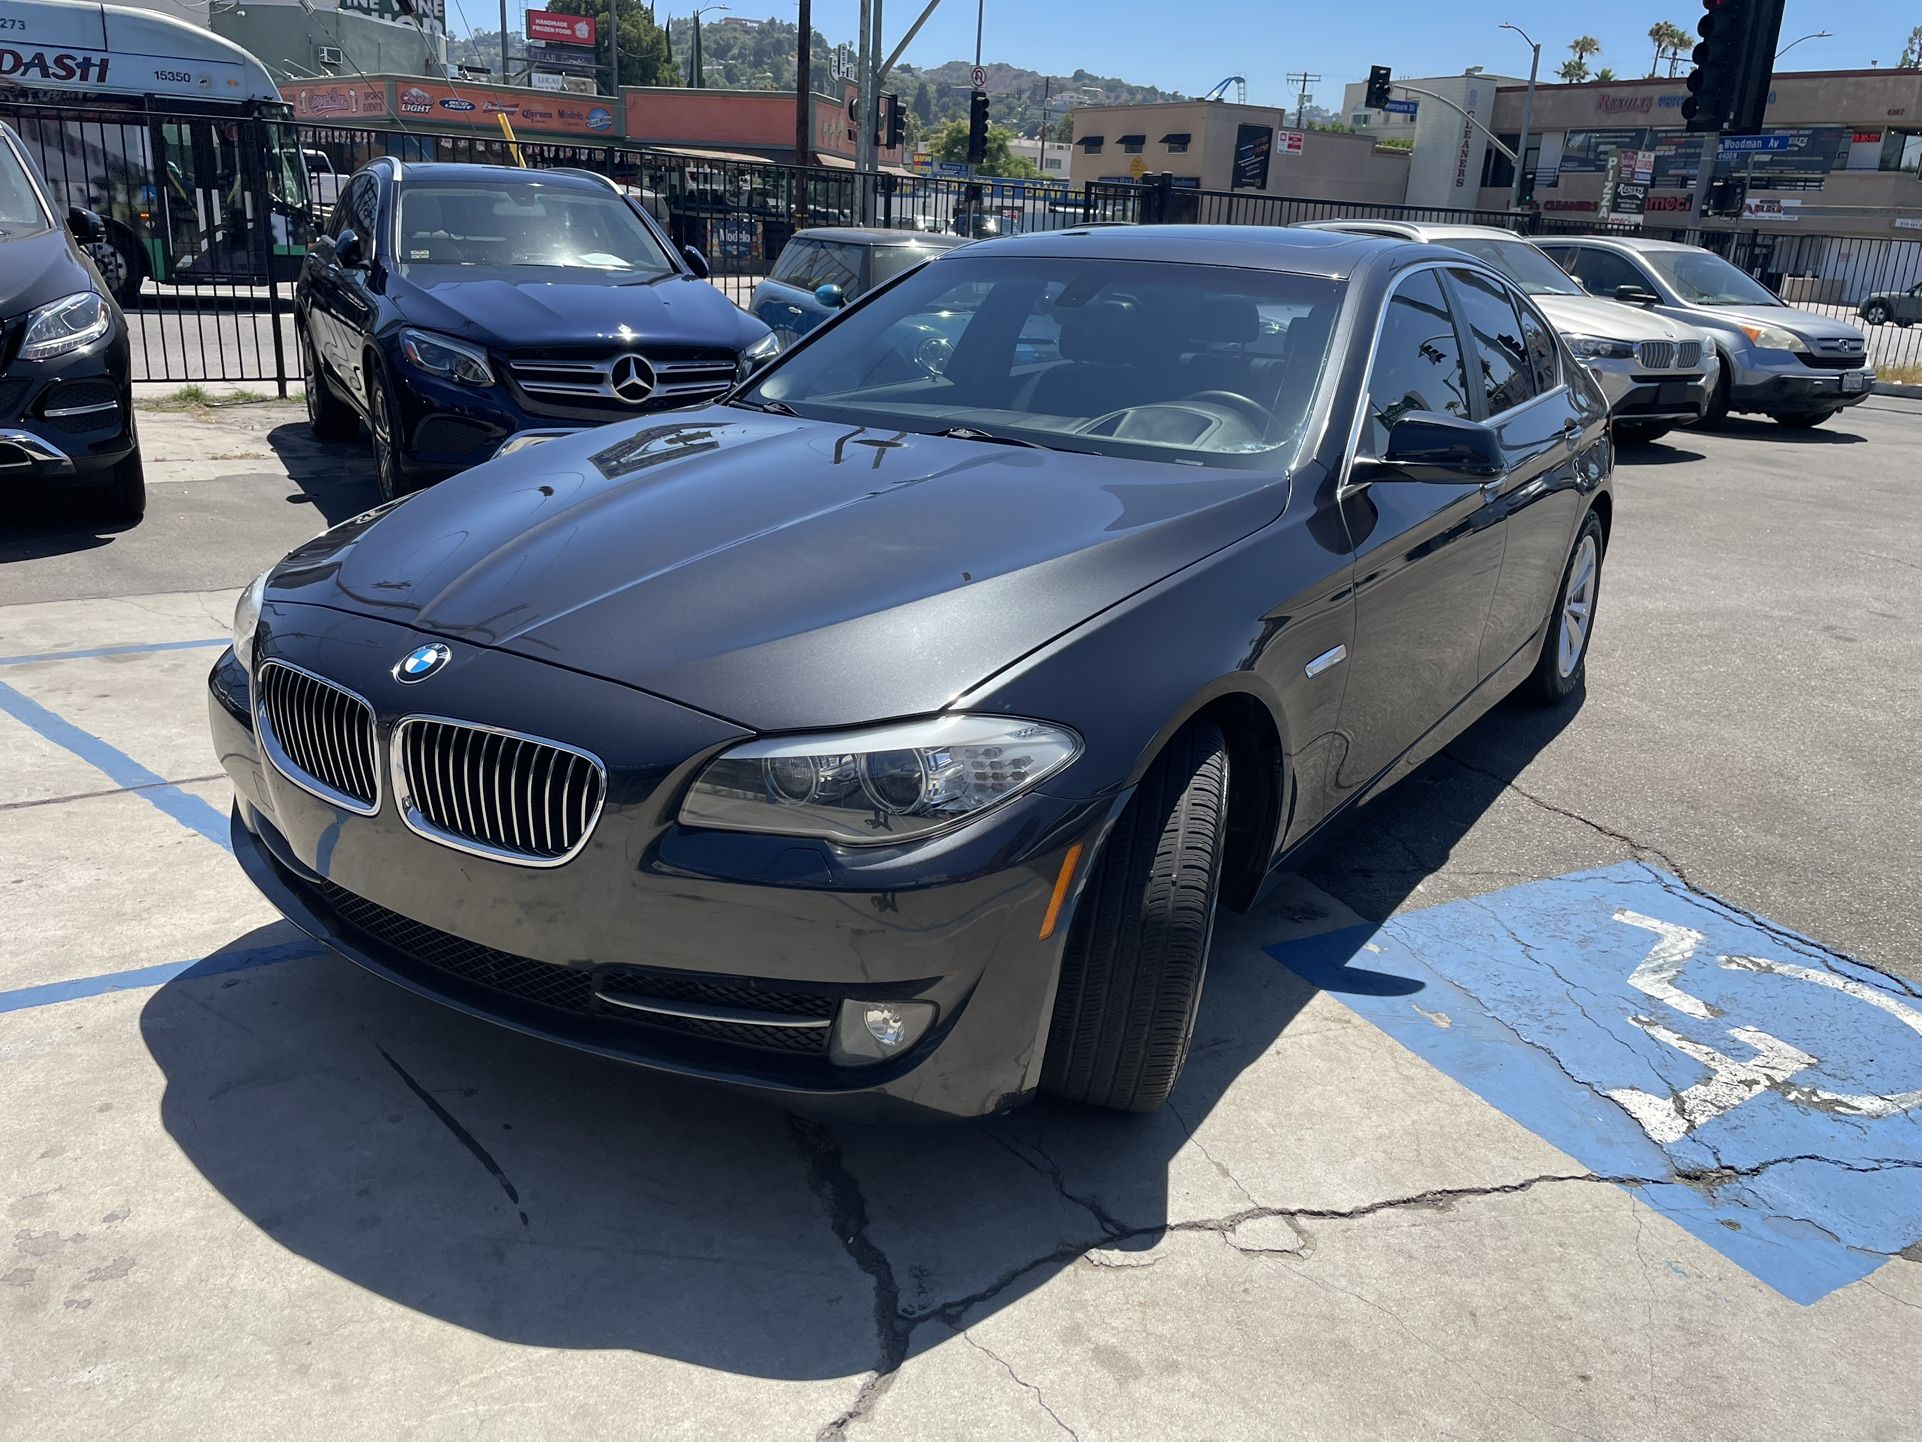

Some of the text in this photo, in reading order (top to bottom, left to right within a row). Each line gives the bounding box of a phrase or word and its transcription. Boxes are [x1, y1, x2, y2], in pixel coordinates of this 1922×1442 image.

[532, 25, 555, 33] FROZEN
[535, 18, 568, 28] HANDMADE
[0, 50, 110, 83] DASH
[154, 70, 191, 83] 15350
[401, 103, 433, 115] LIGHT
[521, 109, 553, 119] Corona
[1456, 110, 1475, 188] CLEANERS
[1724, 139, 1763, 149] Woodman
[1768, 138, 1780, 149] Av
[1598, 157, 1618, 218] PIZZA
[719, 229, 751, 243] Modelo
